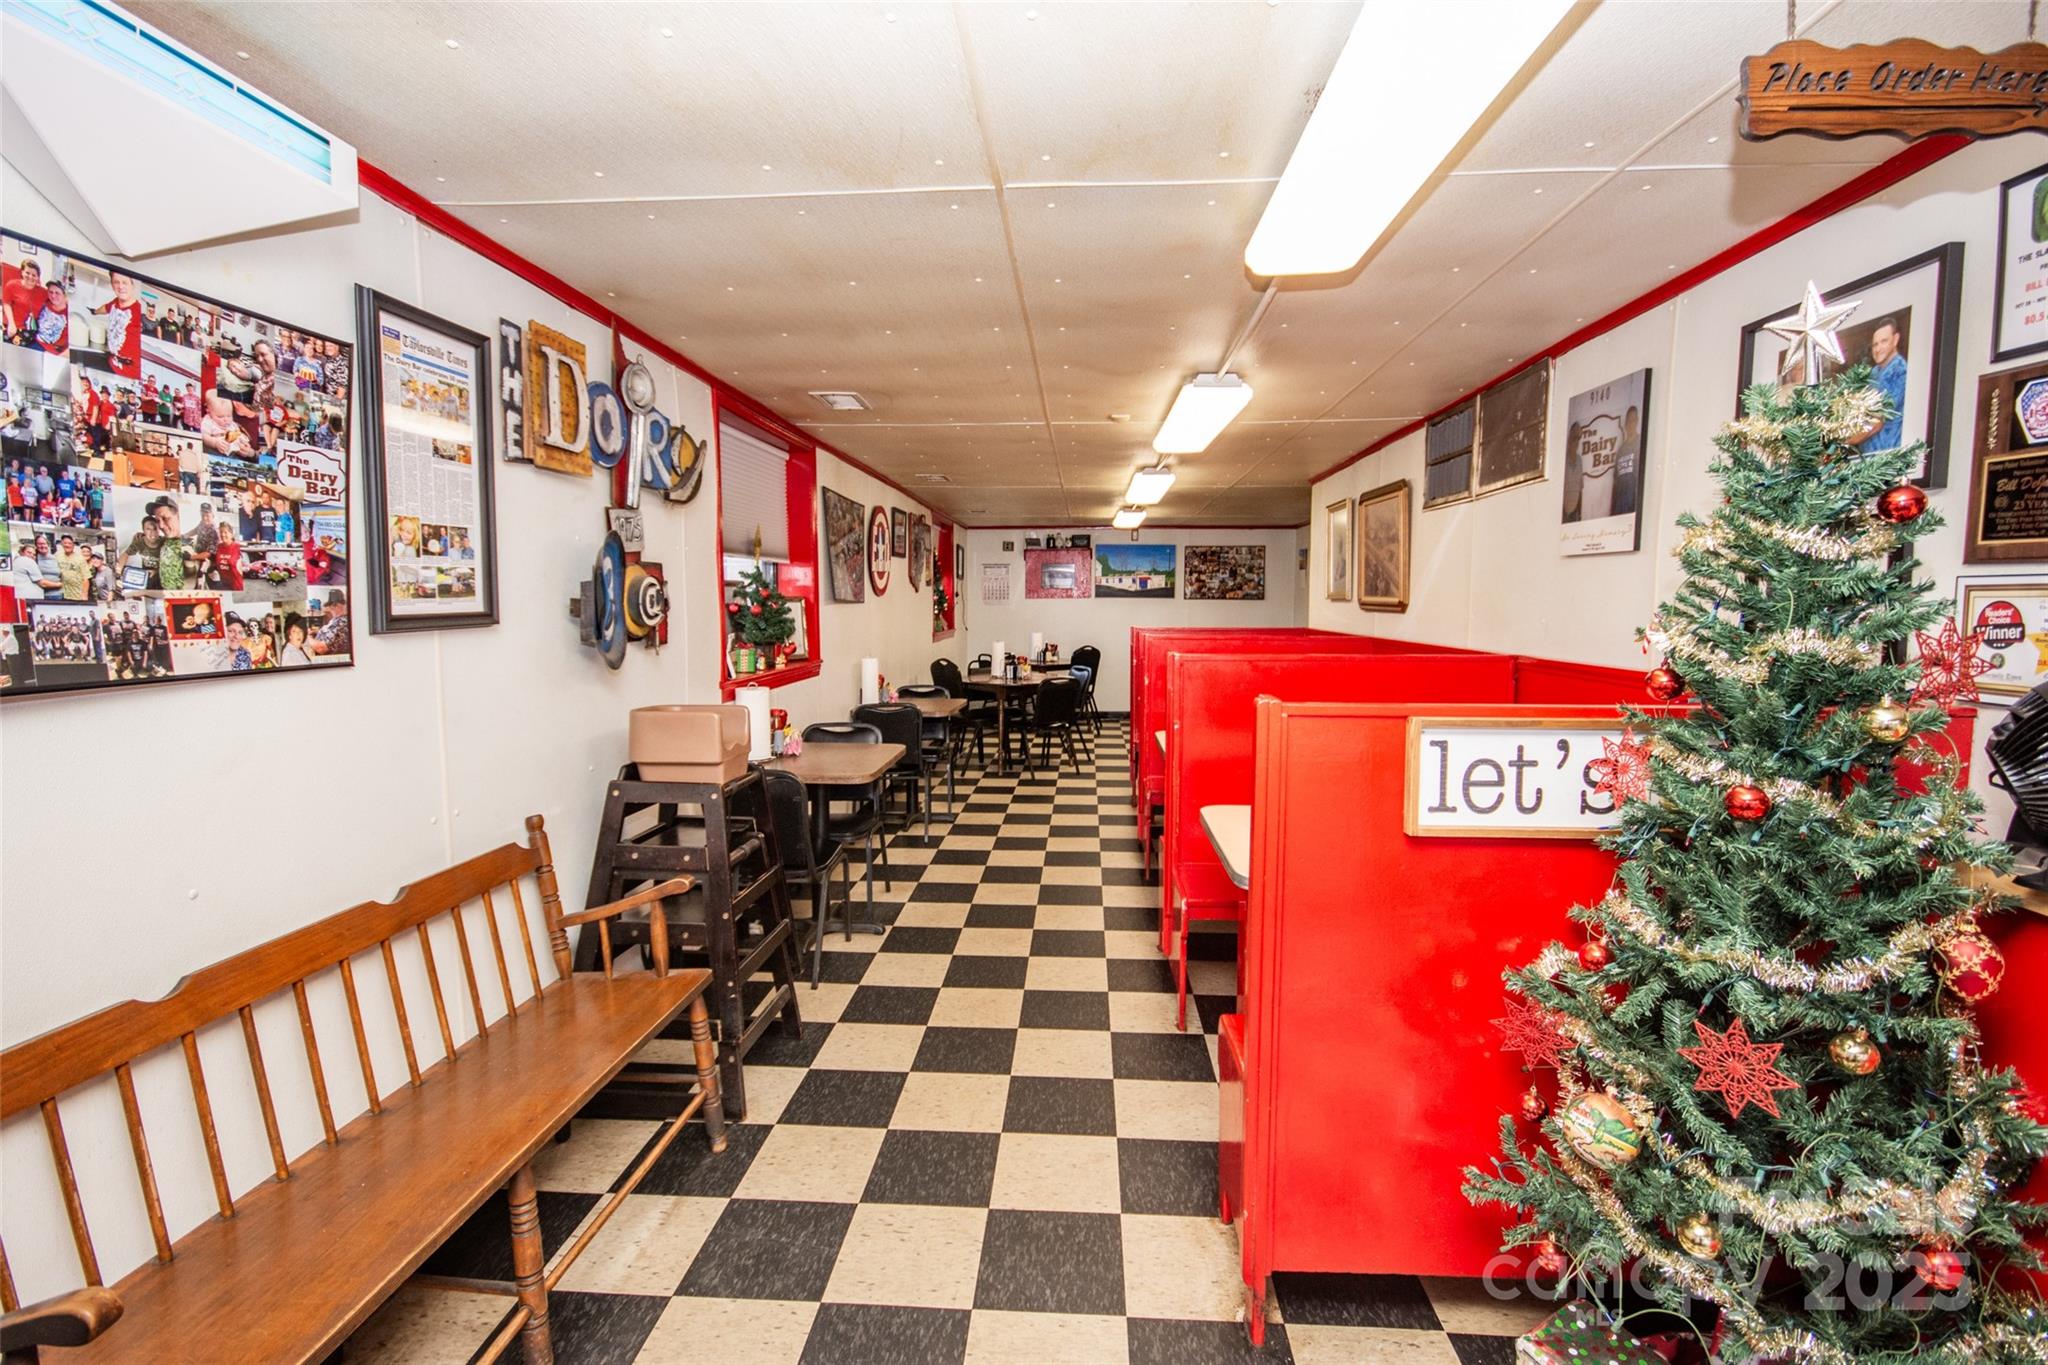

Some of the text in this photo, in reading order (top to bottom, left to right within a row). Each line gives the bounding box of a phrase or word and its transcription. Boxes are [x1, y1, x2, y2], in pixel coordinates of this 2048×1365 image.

[1762, 60, 2048, 94] Place Order Here
[2018, 252, 2033, 264] THE
[2025, 279, 2043, 292] BILL
[501, 324, 523, 459] THE
[1590, 386, 1611, 407] 9140
[1581, 429, 1598, 440] The
[1582, 437, 1618, 457] Dairy
[287, 454, 310, 465] The
[1592, 452, 1616, 469] Bar
[288, 464, 338, 486] Dairy
[305, 481, 338, 497] Bar
[1996, 477, 2018, 492] Bill
[1976, 626, 2023, 641] Winner
